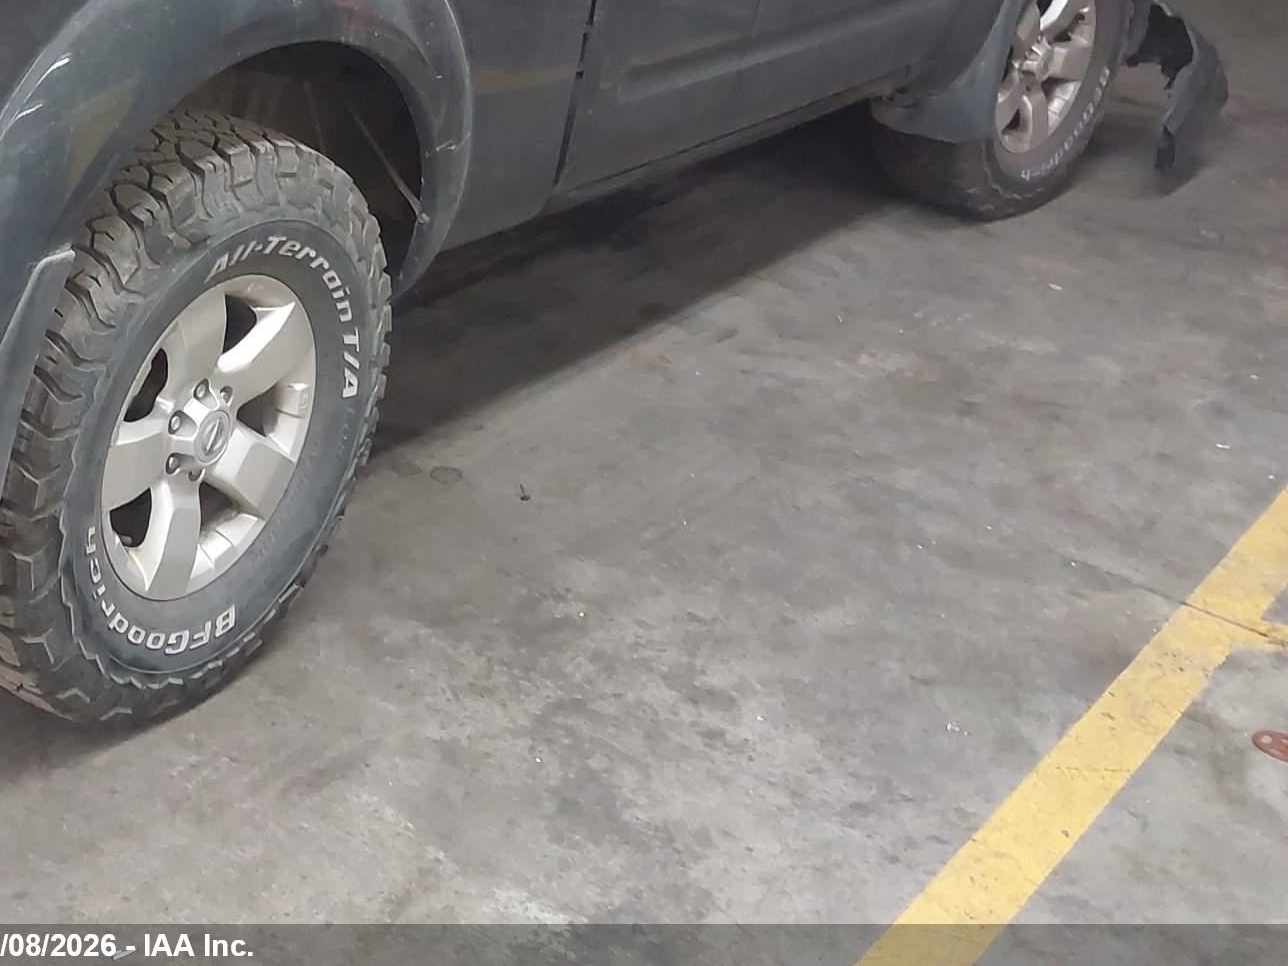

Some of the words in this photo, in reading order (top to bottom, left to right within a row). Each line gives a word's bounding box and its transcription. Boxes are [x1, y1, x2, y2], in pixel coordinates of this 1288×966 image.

[203, 235, 353, 323] All-Terrain
[341, 326, 360, 399] T/A
[85, 525, 236, 655] BFGoodrich
